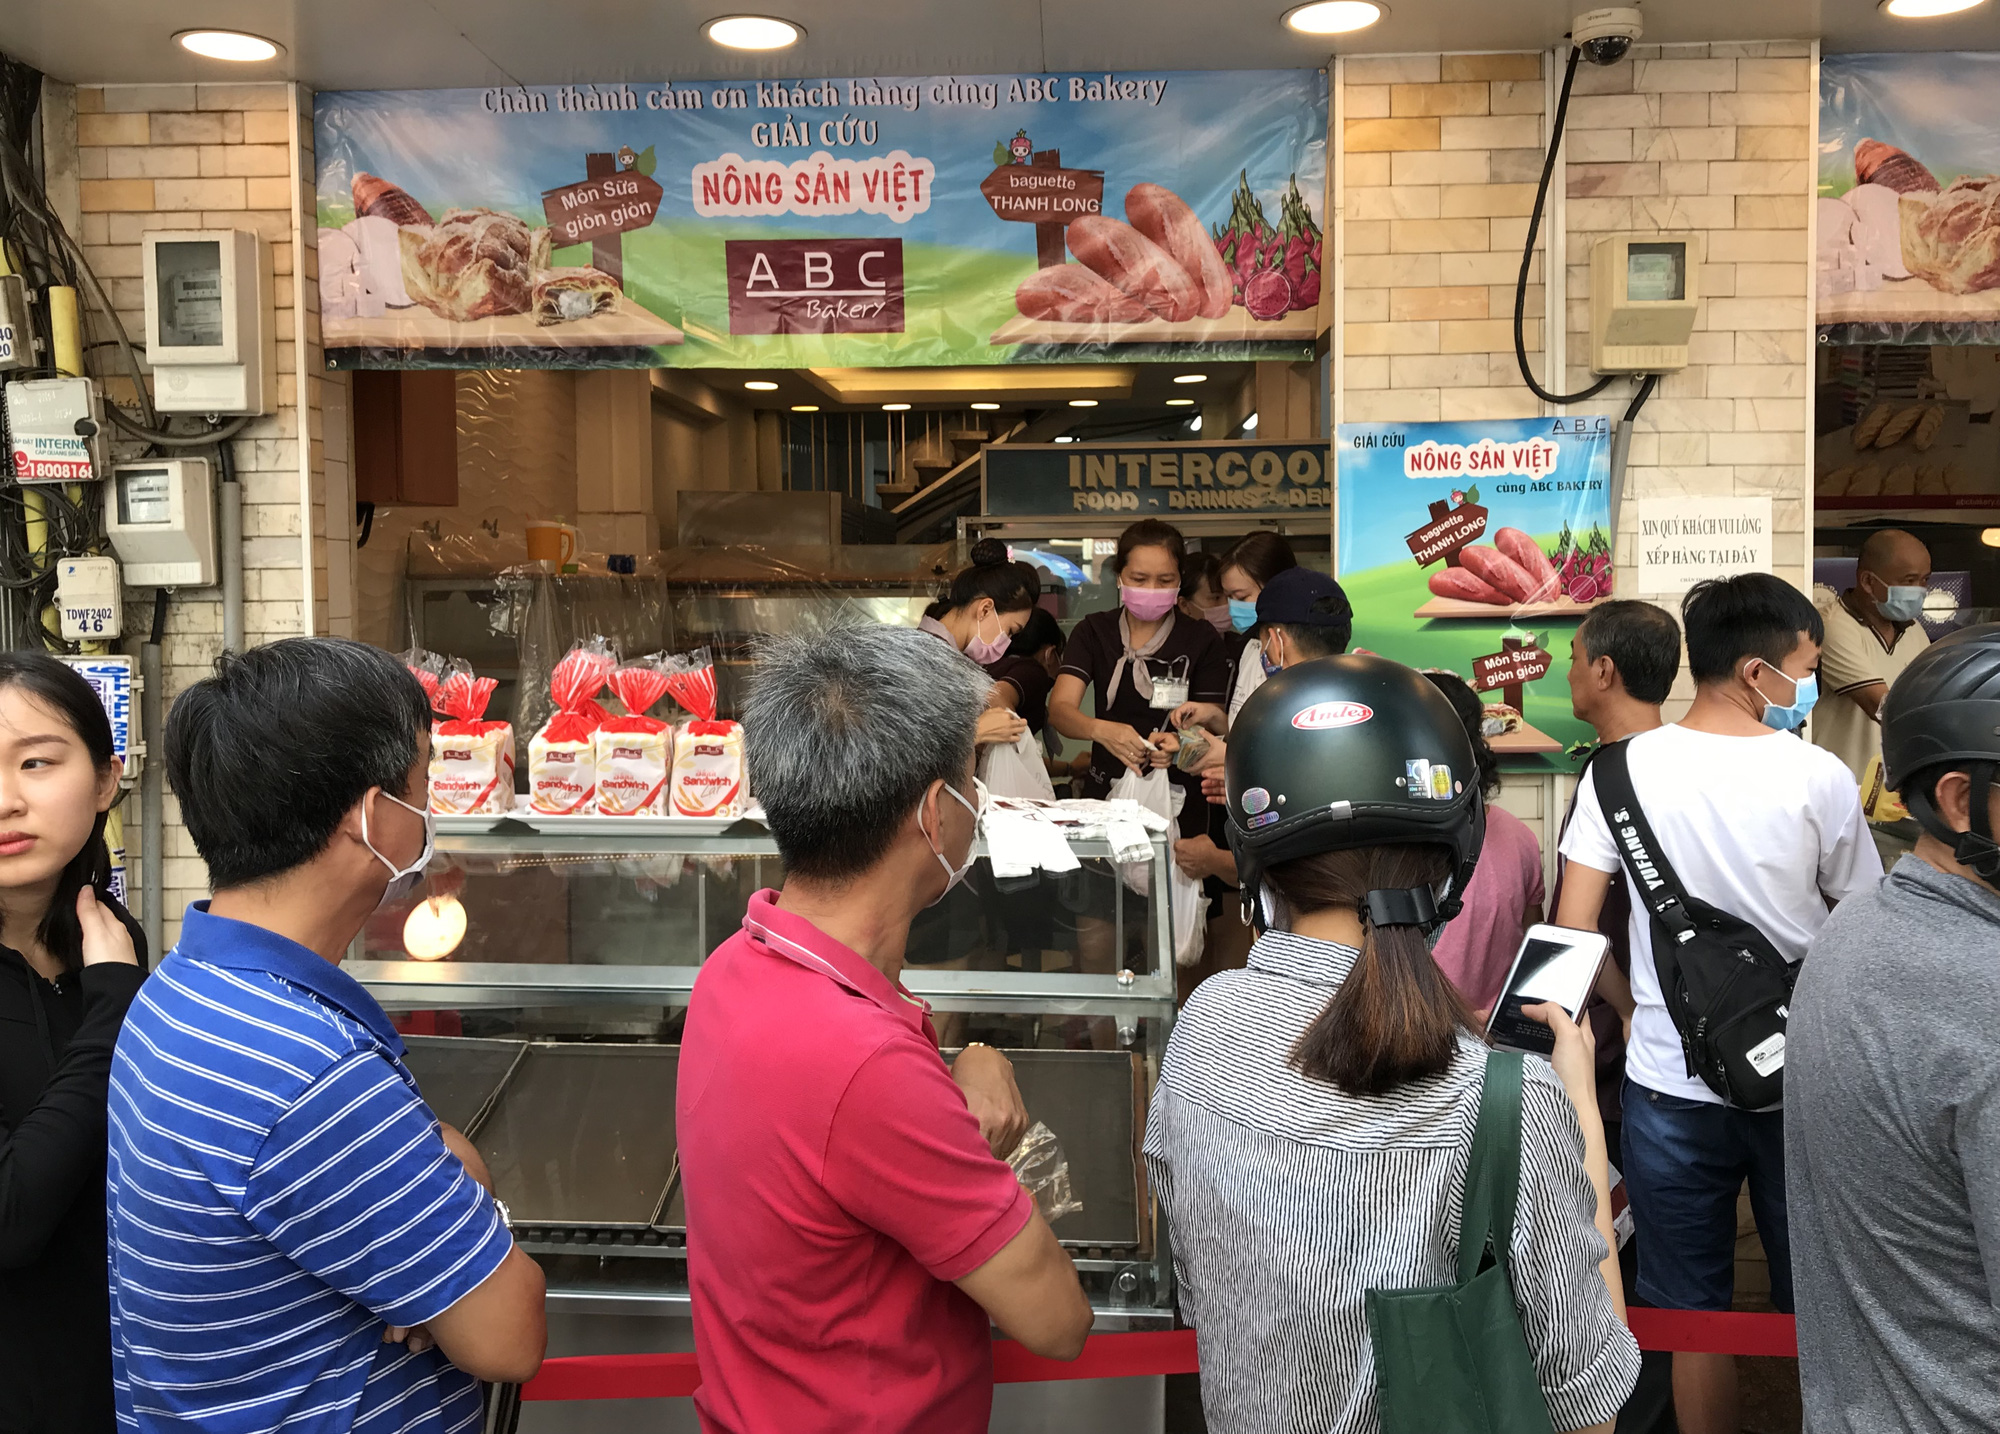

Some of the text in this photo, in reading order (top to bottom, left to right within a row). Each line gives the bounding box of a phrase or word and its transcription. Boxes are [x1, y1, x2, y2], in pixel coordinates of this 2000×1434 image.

[480, 74, 1168, 113] Chân thành cảm ơn khách hàng cùng ABC Bakery
[751, 112, 879, 147] GIẢI CỨU
[703, 161, 924, 212] NÔNG SẢN VIỆT
[1009, 174, 1076, 190] baguette
[560, 180, 639, 211] Môn Sữa
[991, 195, 1099, 212] THANH LONG
[566, 201, 652, 238] giòn giòn
[806, 299, 886, 319] Bakery
[1353, 430, 1406, 449] GIẢI CỨU
[1410, 443, 1553, 473] NÔNG SẢN VIỆT
[1495, 479, 1603, 495] cùng ABC BAKERY
[1073, 491, 1139, 511] FOOD
[1168, 488, 1261, 510] DRINKS
[1419, 514, 1464, 543] baguette
[1642, 513, 1761, 538] XIN QUÝ KHÁCH VUI LÒNG
[1413, 516, 1486, 561] THANH LONG
[1646, 544, 1757, 567] XẾP HÀNG TẠI ĐÂY
[66, 608, 113, 620] TDWF2402
[1484, 651, 1537, 670] Môn Sữa
[1486, 663, 1544, 686] giòn giòn
[1297, 706, 1370, 726] Andes
[433, 780, 481, 791] Sandwich
[537, 780, 583, 793] Sandwich
[602, 779, 649, 791] Sandwich
[683, 776, 731, 786] Sandwich
[1621, 825, 1665, 891] YUFANG
